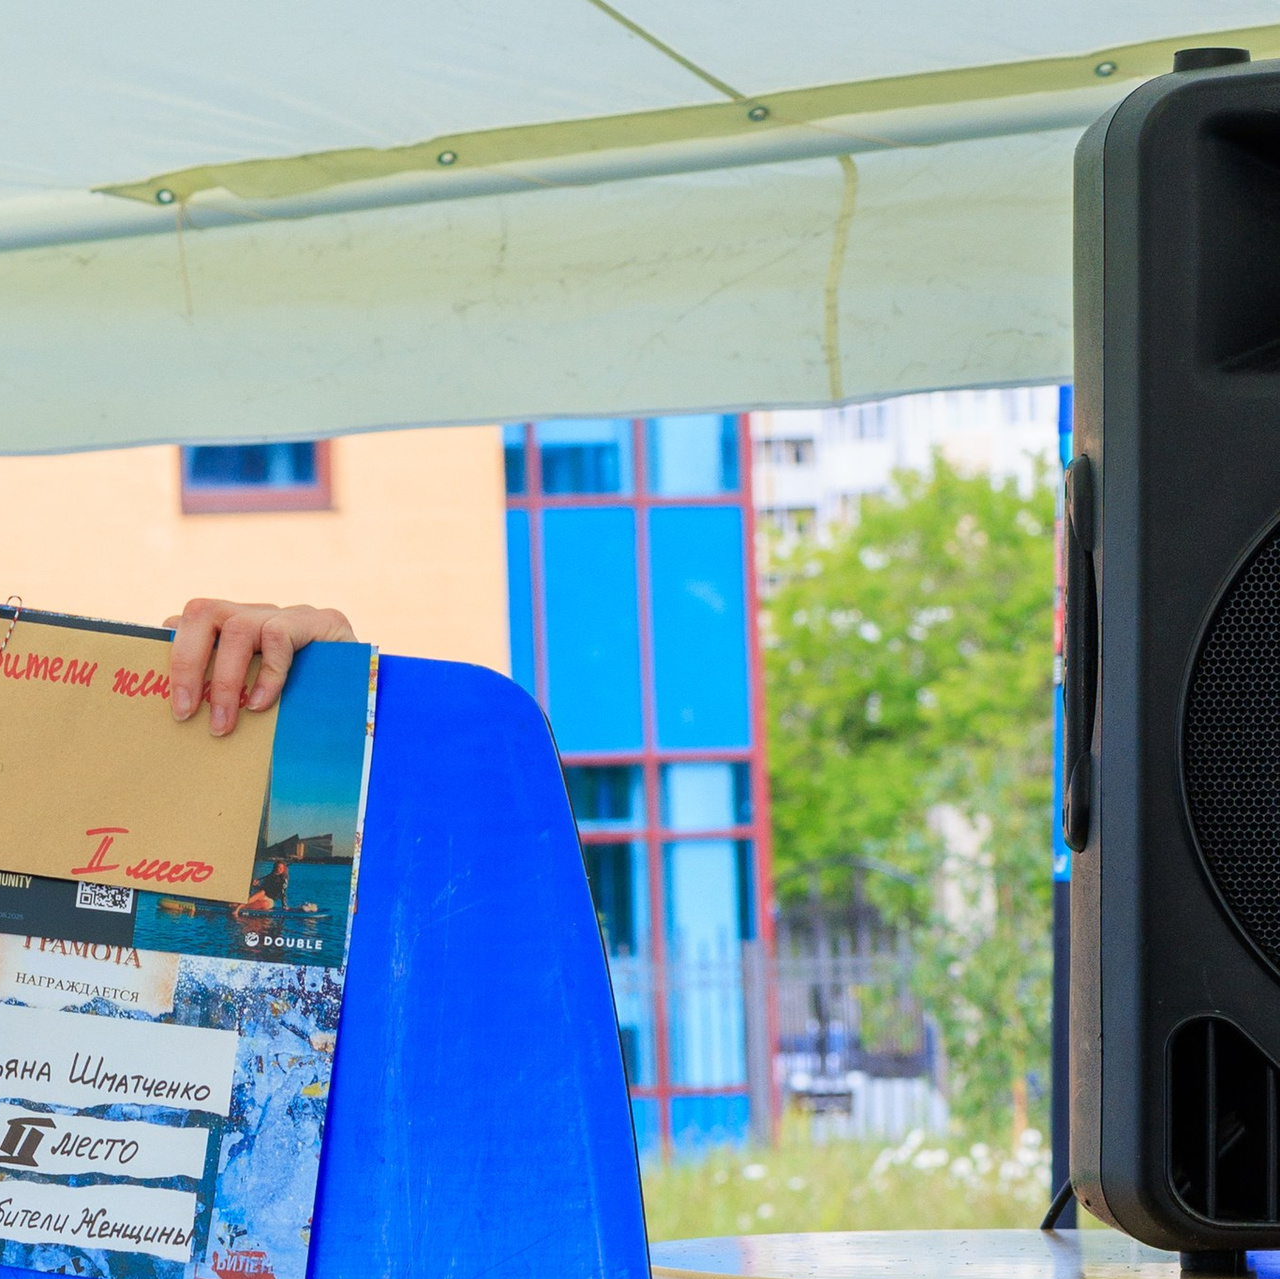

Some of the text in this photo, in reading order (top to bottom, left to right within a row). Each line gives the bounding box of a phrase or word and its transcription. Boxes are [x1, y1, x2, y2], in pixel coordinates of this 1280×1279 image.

[126, 859, 214, 883] место
[263, 936, 323, 950] DOUBLE
[15, 972, 140, 1003] НАГРАЖДАЕТСЯ
[50, 1131, 140, 1165] место
